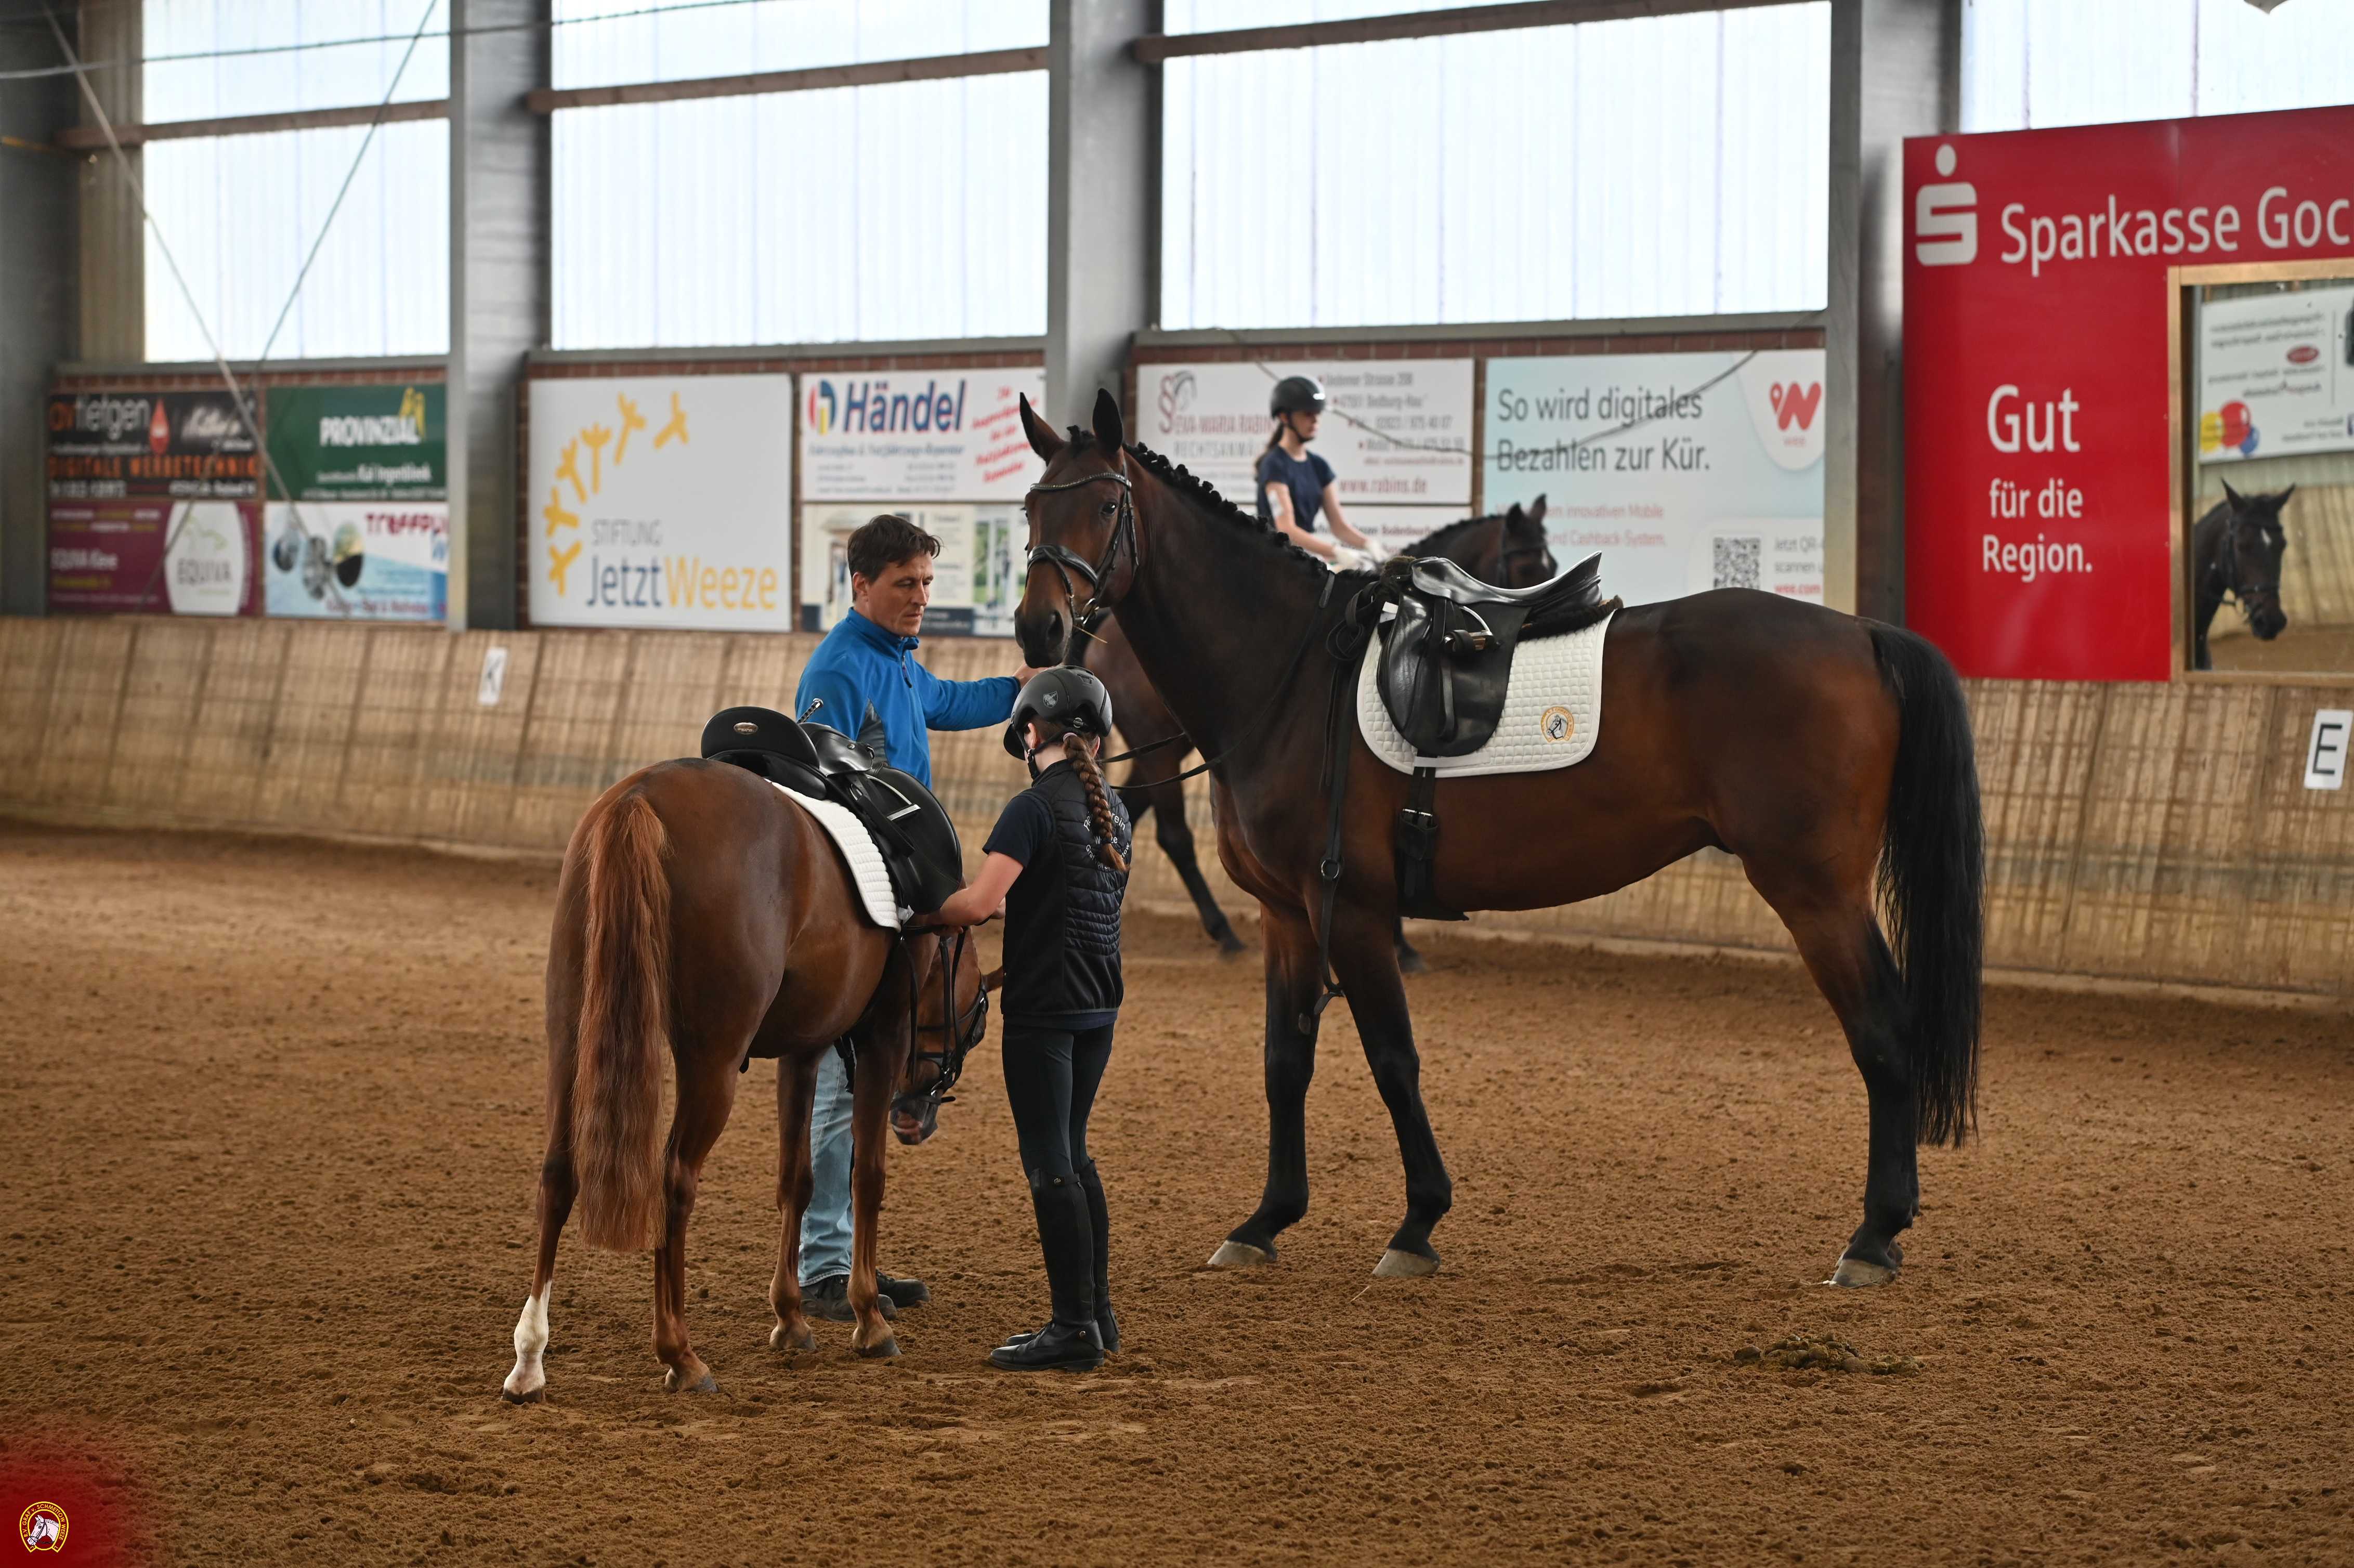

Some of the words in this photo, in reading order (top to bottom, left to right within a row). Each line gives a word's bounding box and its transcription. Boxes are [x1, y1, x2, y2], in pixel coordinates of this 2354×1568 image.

[2001, 194, 2240, 276] Sparkasse
[2258, 187, 2350, 249] Goc
[843, 379, 967, 433] Händel
[1498, 388, 1527, 422] So
[1536, 387, 1589, 421] wird
[1598, 387, 1703, 428] digitales
[1987, 384, 2081, 452] Gut
[320, 415, 421, 447] PROVINZIAL
[1498, 438, 1606, 472] Bezahlen
[1615, 447, 1654, 471] zur
[1663, 437, 1710, 471] Kür.
[1990, 478, 2031, 518] für
[2038, 479, 2083, 518] die
[591, 520, 661, 548] STIFTUNG
[1983, 535, 2093, 582] Region.
[2313, 723, 2343, 775] E
